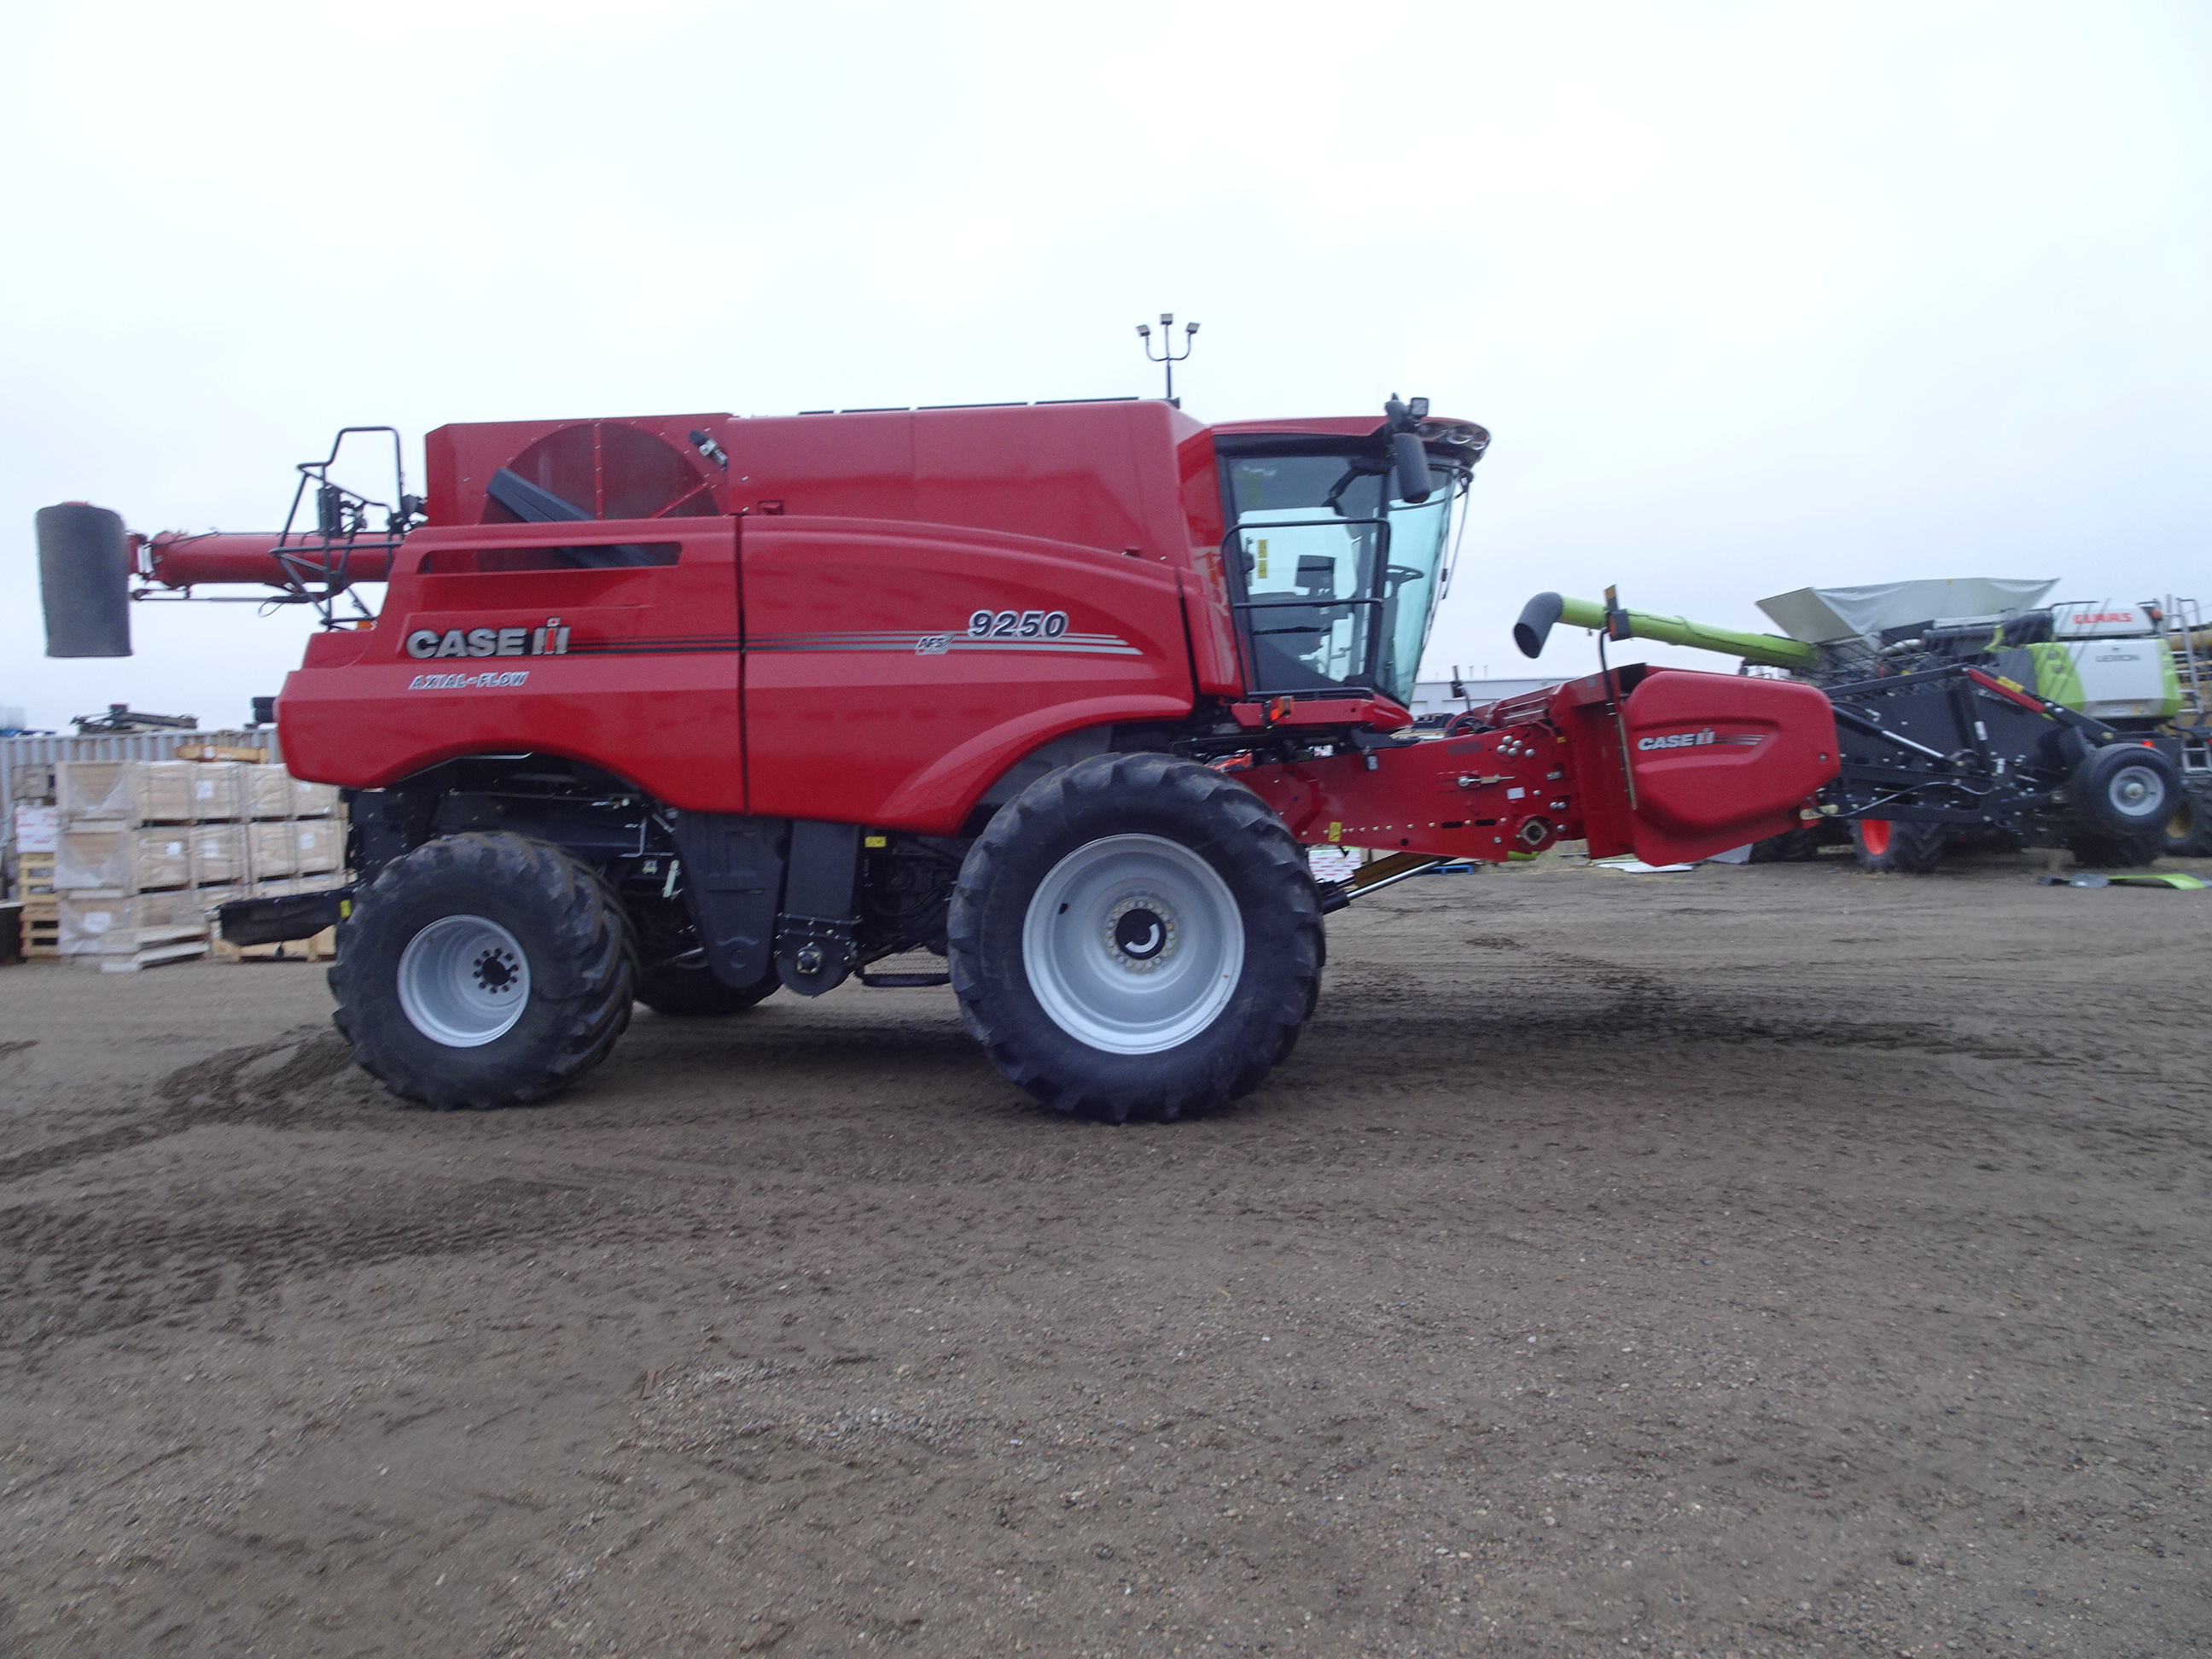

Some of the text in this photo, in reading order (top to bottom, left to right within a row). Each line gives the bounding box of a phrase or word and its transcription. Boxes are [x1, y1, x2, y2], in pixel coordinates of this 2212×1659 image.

[967, 609, 1068, 638] 9250
[2073, 612, 2133, 625] CLAAS
[405, 627, 528, 659] CASE
[408, 671, 530, 690] AXIAL-FLOW
[1637, 732, 1695, 752] CASE
